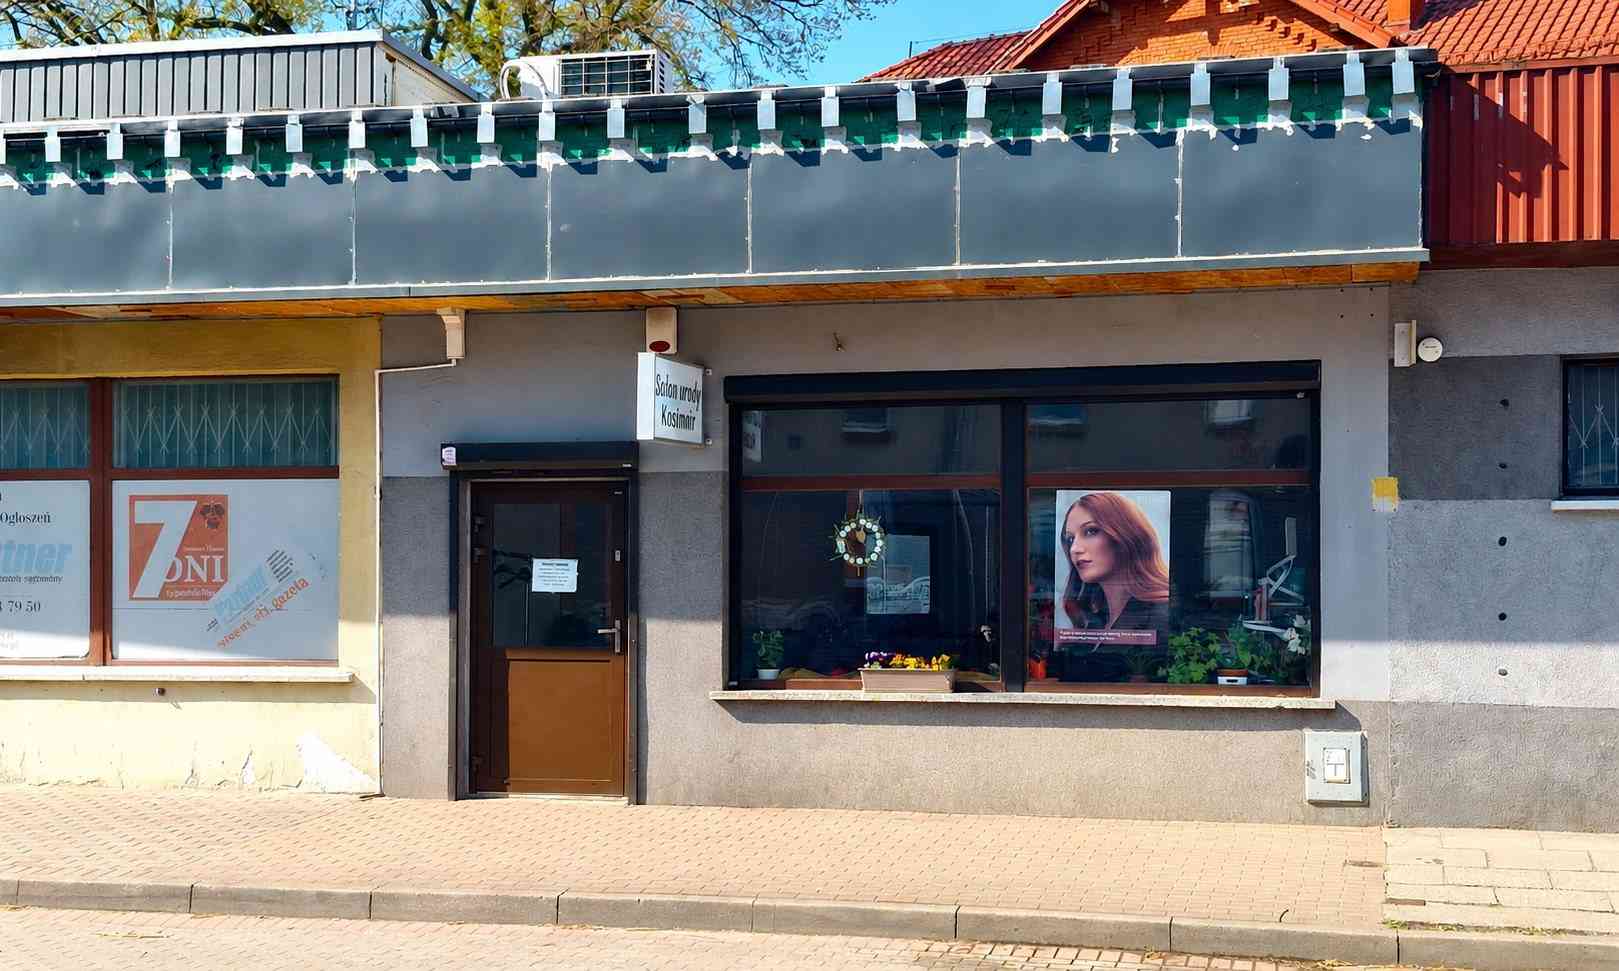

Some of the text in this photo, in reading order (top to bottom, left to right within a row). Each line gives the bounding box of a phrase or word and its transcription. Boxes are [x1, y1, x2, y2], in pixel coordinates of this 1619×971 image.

[655, 374, 702, 411] Salon urody
[0, 541, 72, 575] tner
[134, 500, 198, 598] 7
[164, 555, 225, 582] DNI
[8, 600, 22, 612] 79
[26, 600, 41, 612] 50
